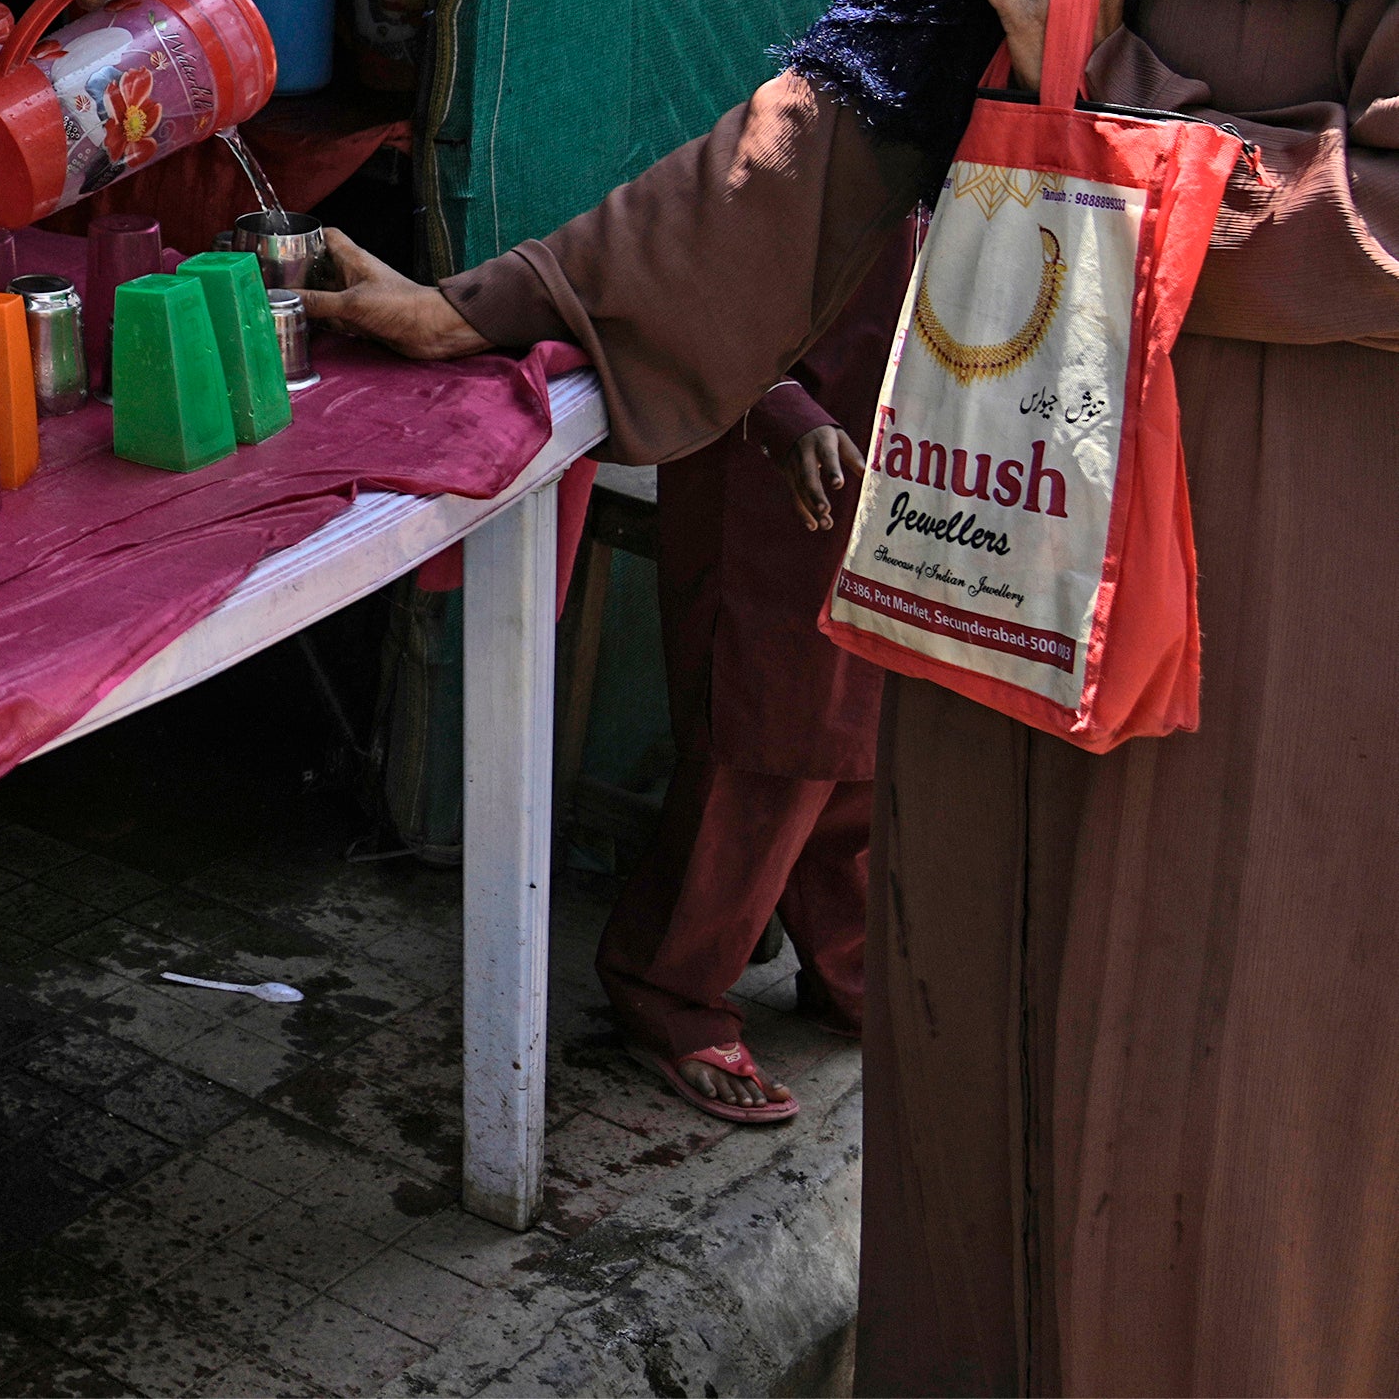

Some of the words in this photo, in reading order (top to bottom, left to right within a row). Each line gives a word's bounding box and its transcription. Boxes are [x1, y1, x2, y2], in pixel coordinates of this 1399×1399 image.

[1042, 187, 1067, 202] Tanush
[871, 404, 1069, 519] Tanush
[885, 491, 1011, 556] Jewellers
[873, 544, 914, 572] Showcase
[915, 560, 926, 580] of
[925, 563, 967, 588] Indian
[968, 576, 1025, 608] Jewellery
[874, 589, 892, 608] Pot
[892, 595, 932, 623] Market,
